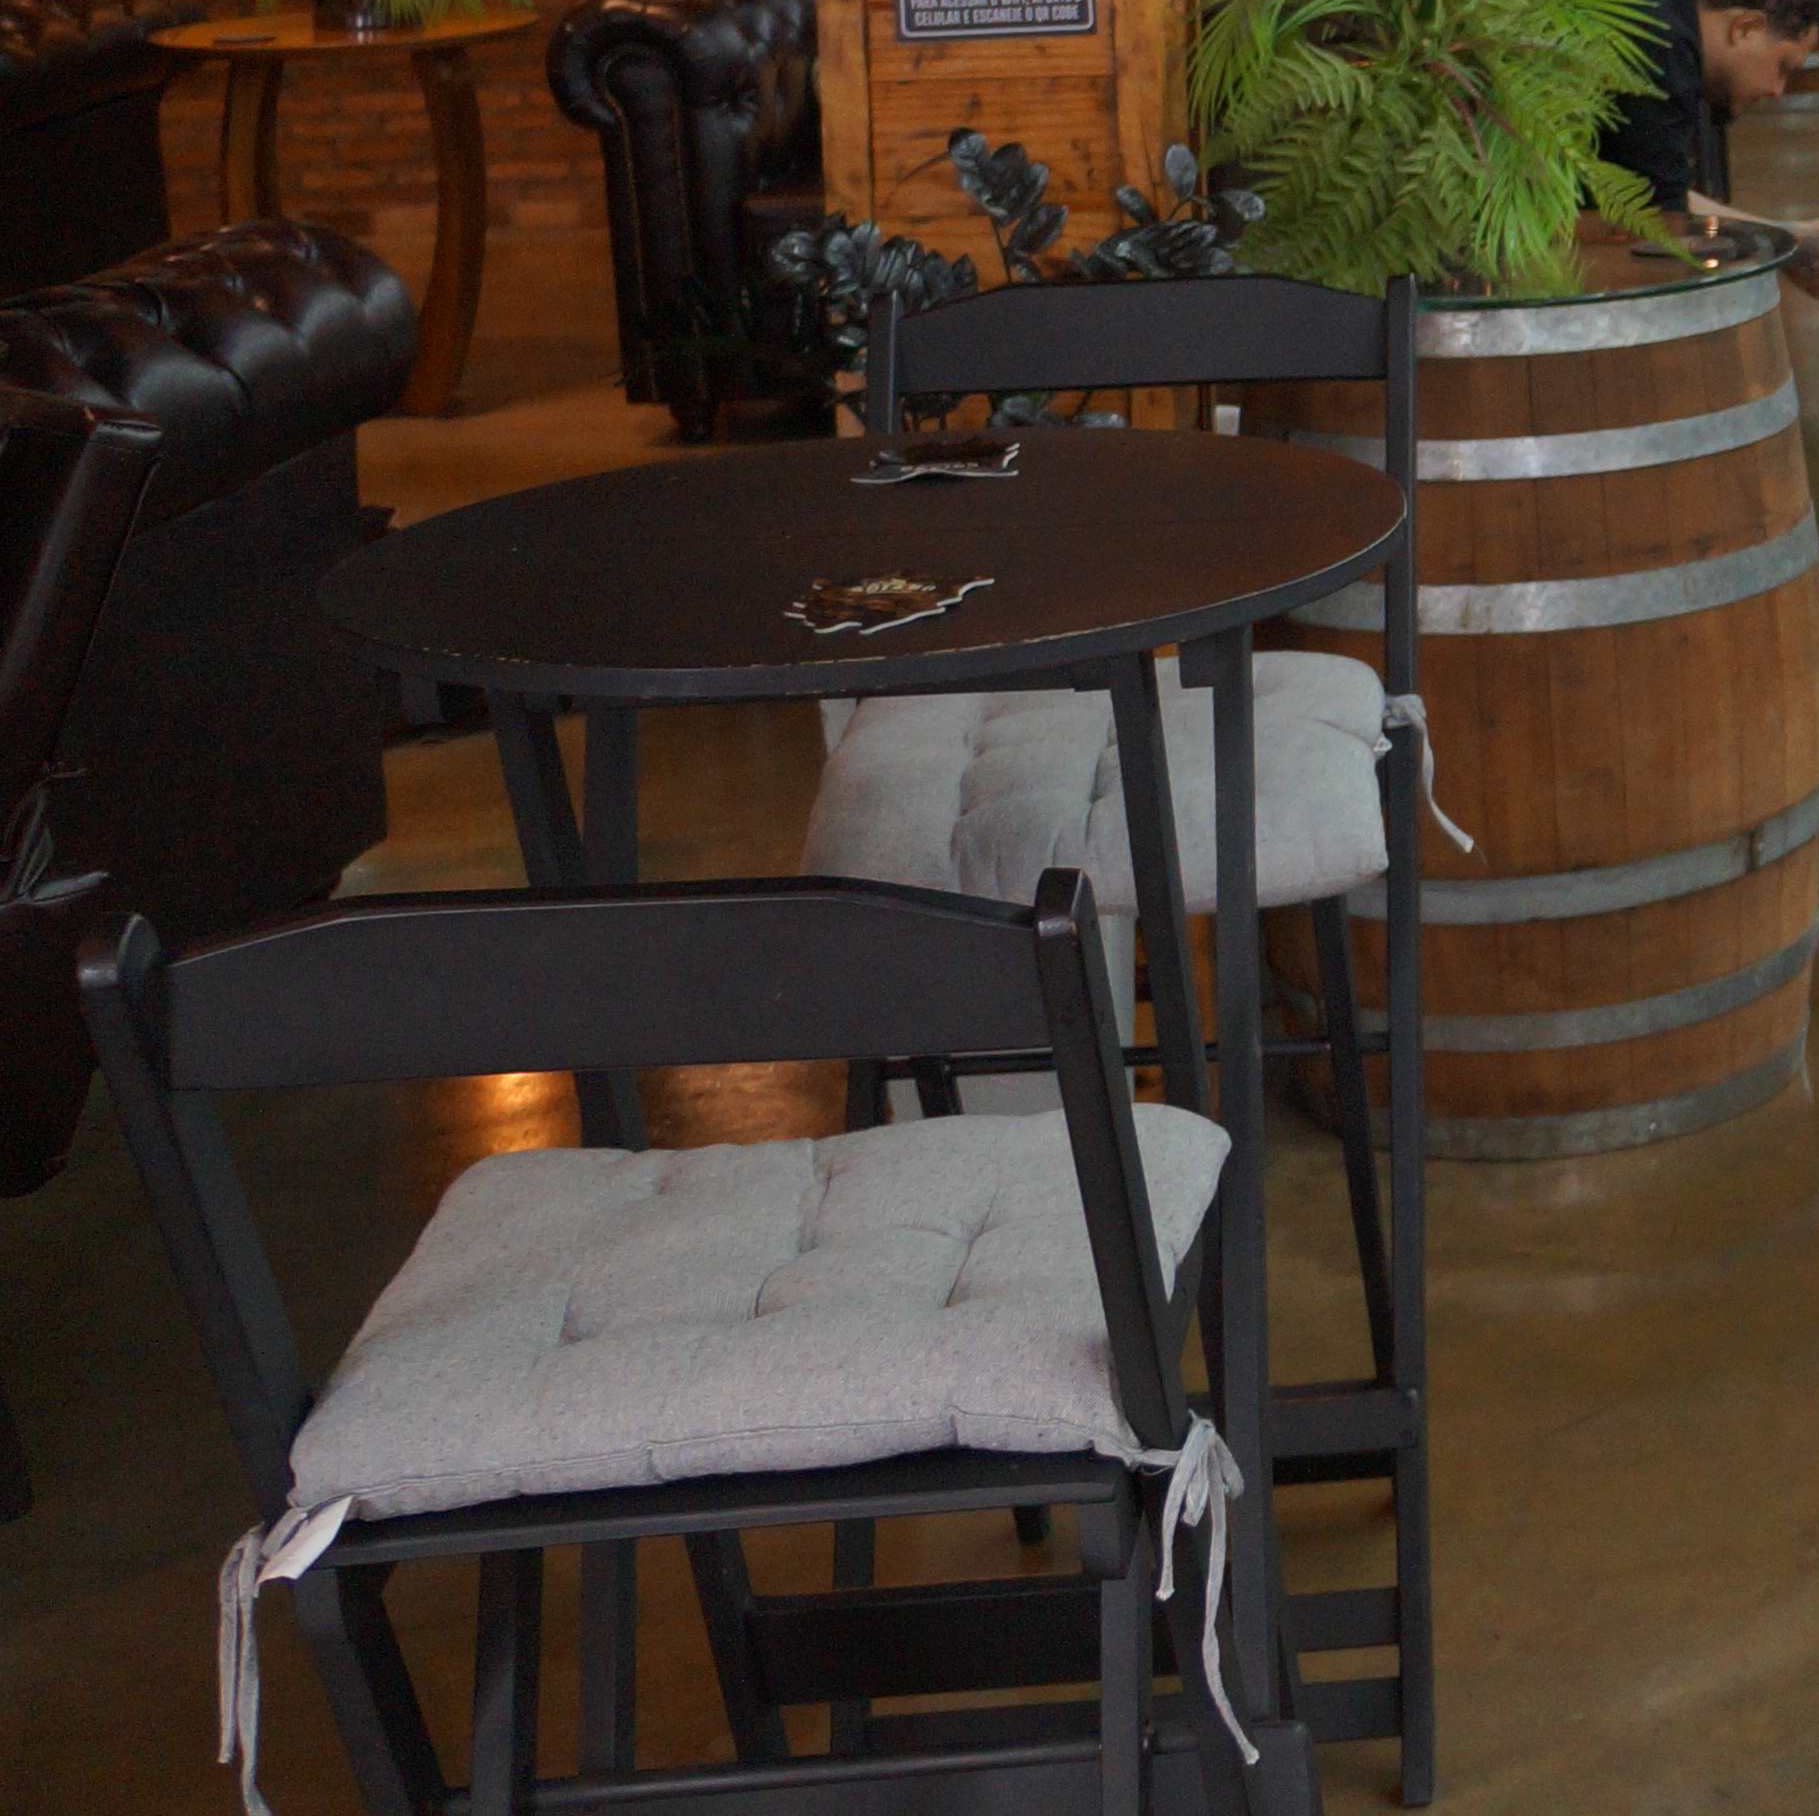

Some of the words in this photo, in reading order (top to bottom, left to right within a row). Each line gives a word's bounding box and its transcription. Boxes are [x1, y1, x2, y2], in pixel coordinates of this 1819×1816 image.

[915, 10, 961, 26] CELULAR
[1035, 6, 1049, 22] QR
[1052, 5, 1079, 21] CODE
